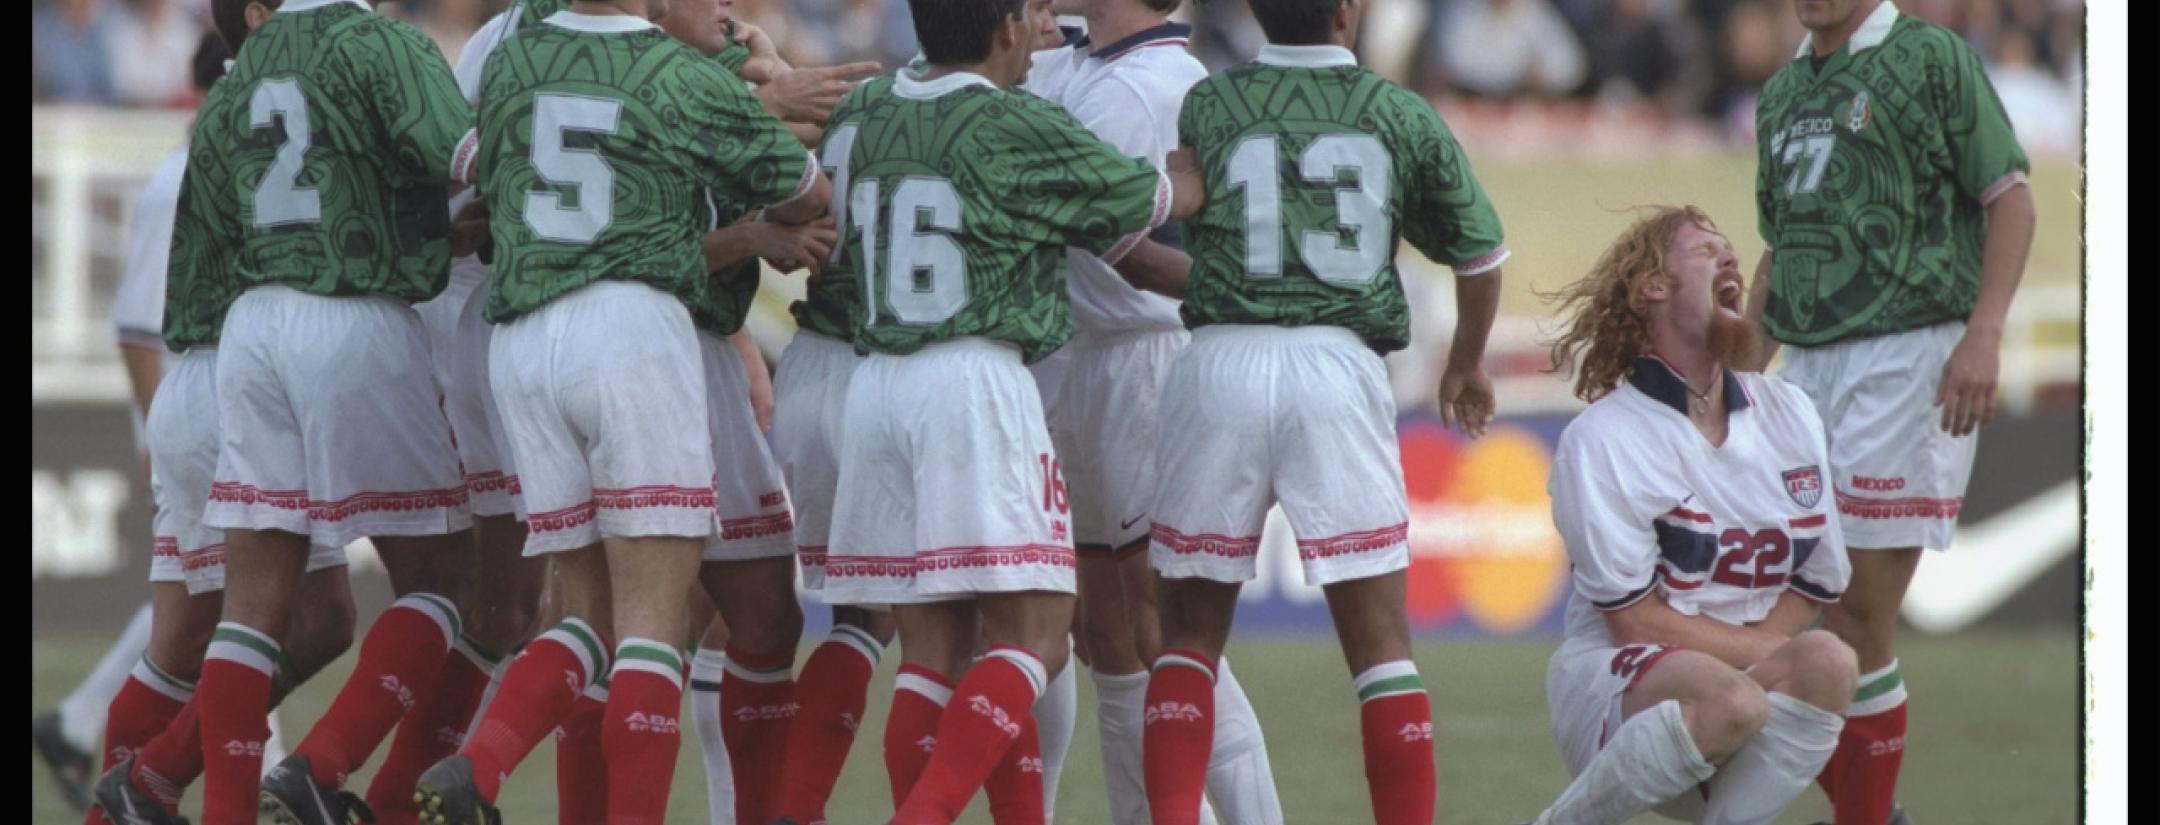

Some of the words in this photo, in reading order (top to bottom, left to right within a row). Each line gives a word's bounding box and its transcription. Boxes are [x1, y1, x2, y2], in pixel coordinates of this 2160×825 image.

[248, 78, 321, 228] 2
[522, 91, 624, 245] 5
[1227, 133, 1393, 285] 13
[851, 174, 970, 329] 16
[1040, 452, 1070, 515] 16
[1851, 474, 1905, 491] MEXICO
[1710, 527, 1790, 589] 22
